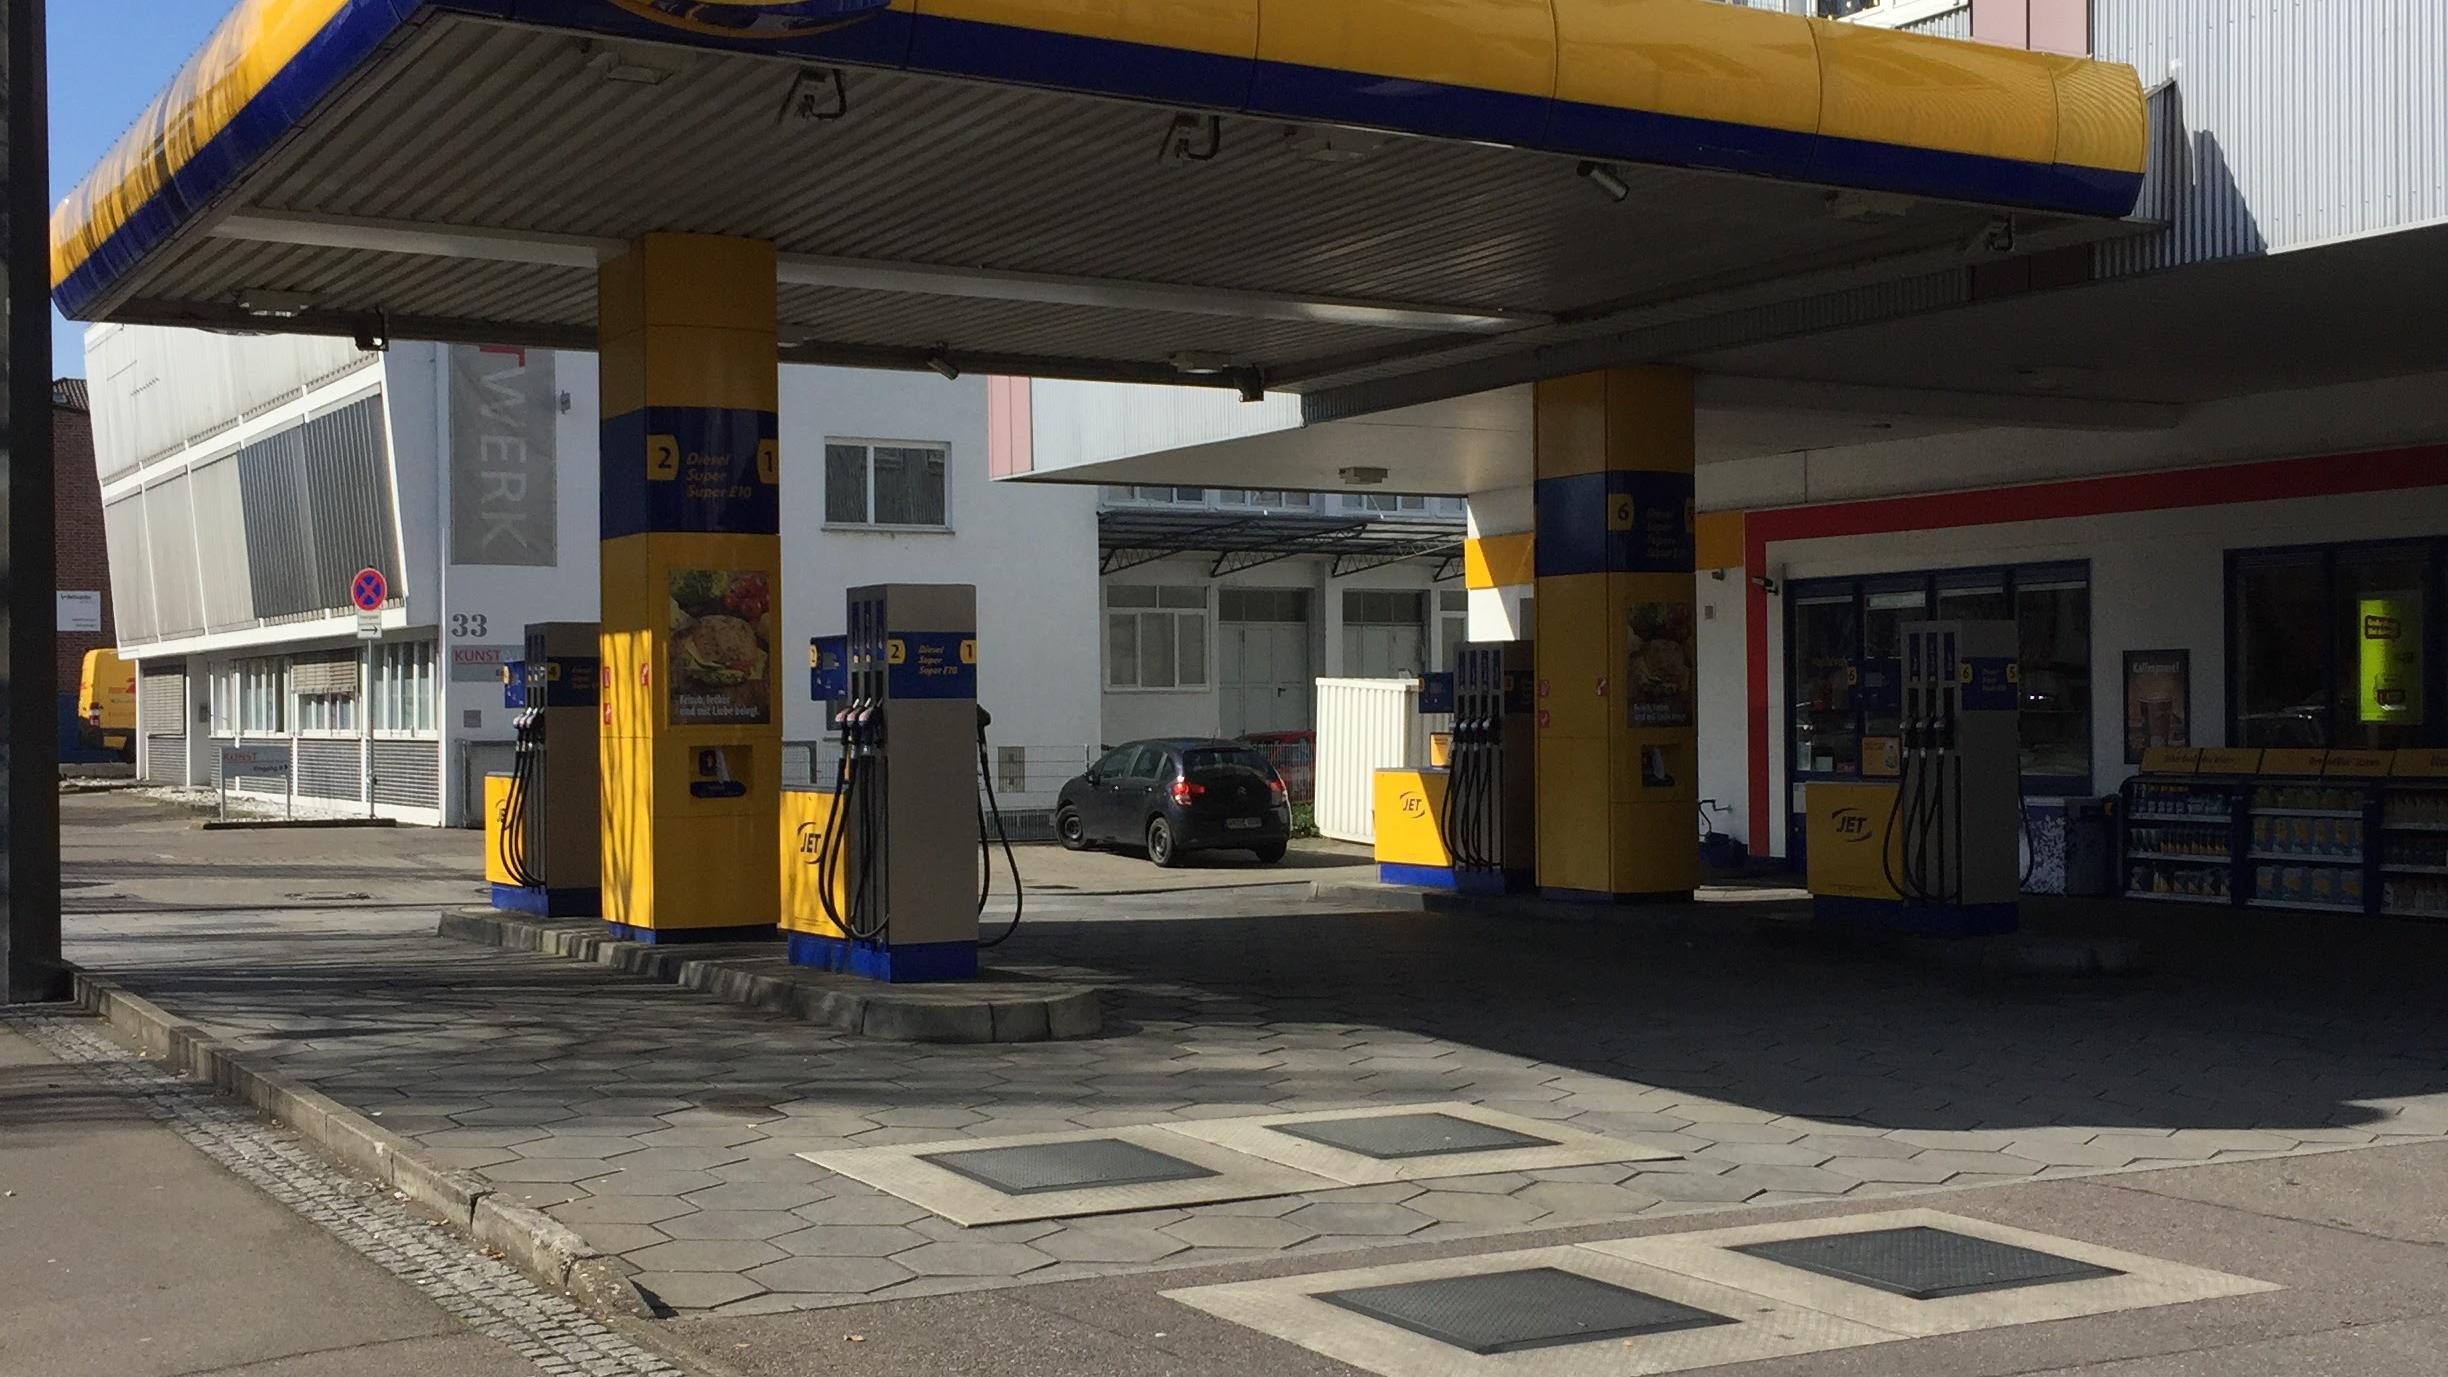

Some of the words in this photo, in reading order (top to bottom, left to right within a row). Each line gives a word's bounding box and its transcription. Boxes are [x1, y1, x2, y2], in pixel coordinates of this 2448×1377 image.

[657, 446, 673, 469] 2
[686, 452, 729, 466] Diesel
[763, 450, 774, 473] 1
[686, 468, 727, 482] Super
[686, 484, 726, 500] Super
[728, 485, 753, 498] E10
[1618, 502, 1629, 521] 6
[451, 613, 488, 638] 33
[891, 644, 900, 659] 2
[918, 644, 945, 654] Diesel
[966, 643, 973, 659] 1
[1962, 667, 1970, 679] 6
[2009, 666, 2016, 679] 5
[1402, 798, 1423, 811] JET
[1836, 815, 1867, 833] JET
[800, 832, 822, 853] JET
